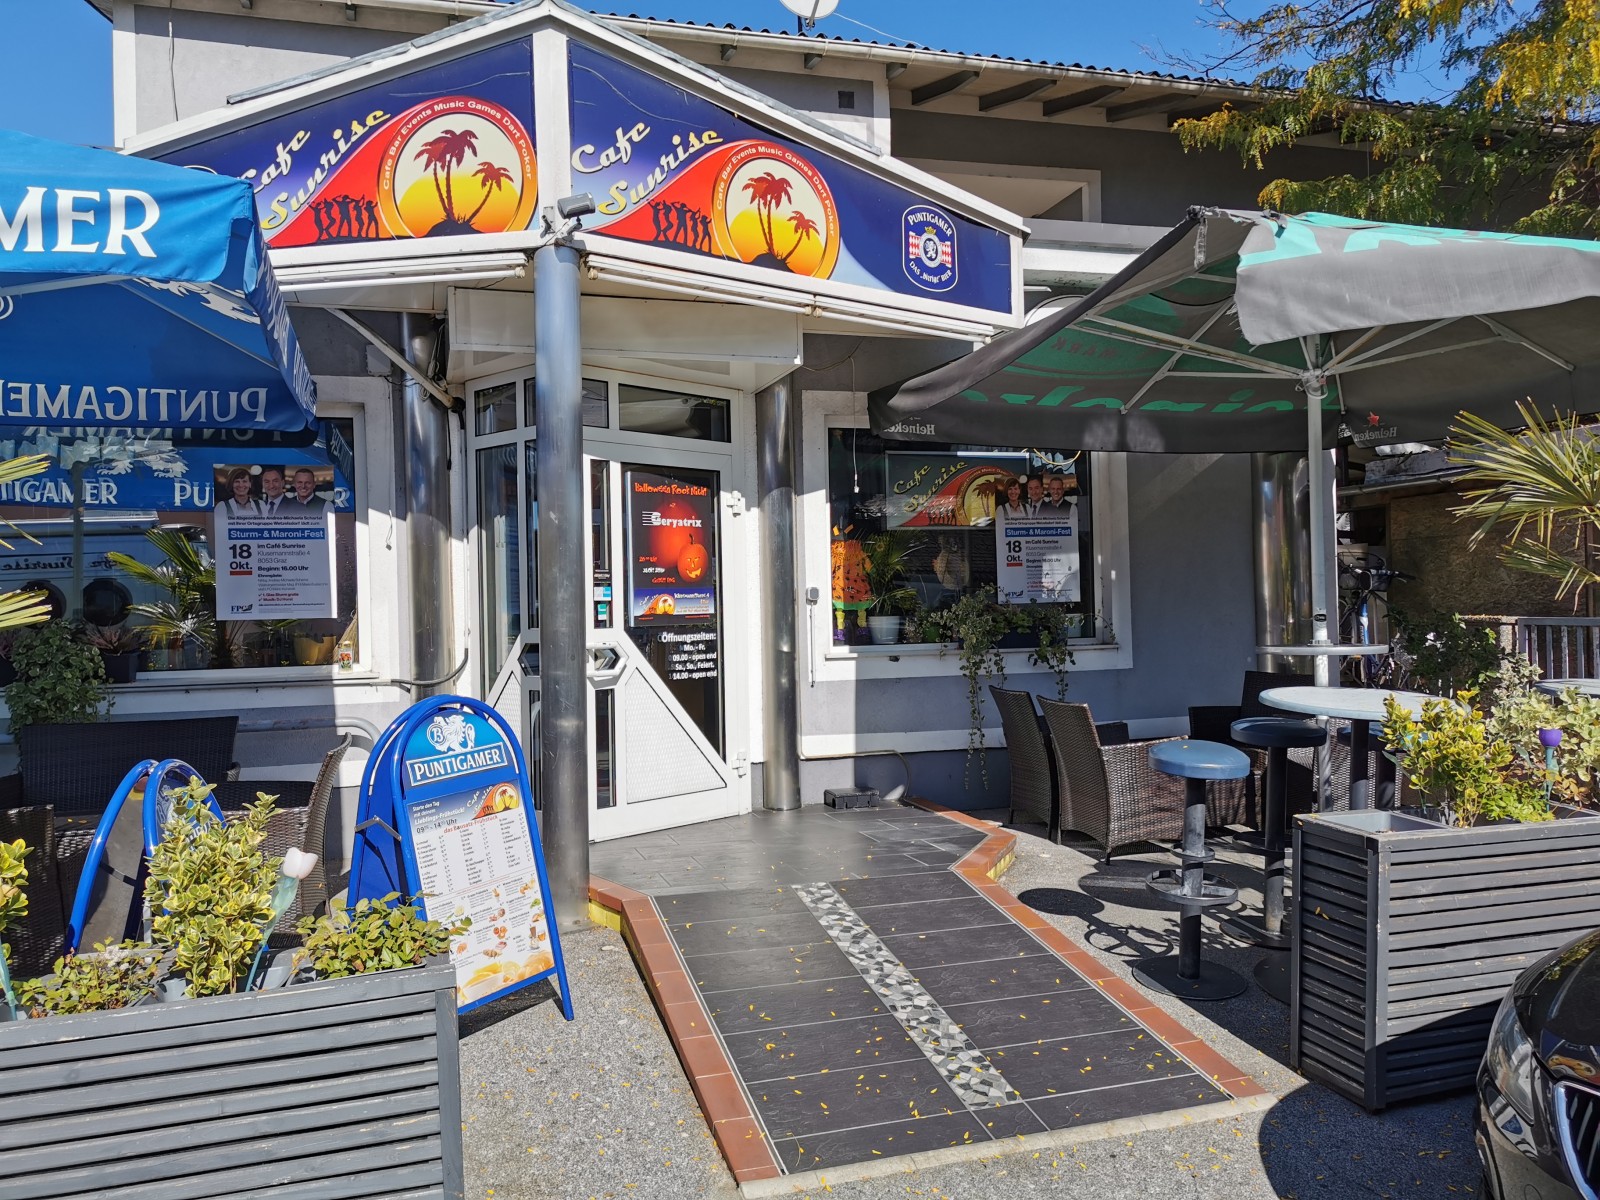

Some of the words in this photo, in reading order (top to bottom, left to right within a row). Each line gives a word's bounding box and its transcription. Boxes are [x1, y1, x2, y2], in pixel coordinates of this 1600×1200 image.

[383, 159, 392, 190] Cafe
[390, 136, 402, 156] Bar
[401, 108, 432, 134] Events
[433, 100, 465, 112] Music
[467, 102, 502, 120] Games
[502, 117, 520, 138] Dart
[518, 139, 532, 181] Poker
[571, 122, 650, 174] Cafe
[260, 110, 391, 229] Sunrise
[597, 130, 724, 215] Sunrise
[717, 182, 725, 210] Cafe
[722, 162, 732, 180] Bar
[731, 148, 756, 164] Events
[758, 146, 782, 156] Music
[784, 152, 813, 176] Games
[813, 176, 827, 198] Dart
[825, 200, 834, 237] Poker
[907, 212, 952, 237] PUNTIGAMER
[909, 261, 921, 275] DAS
[893, 464, 931, 494] Cafe
[904, 461, 968, 512] Sunrise
[229, 544, 252, 559] 18
[1006, 540, 1022, 553] 18
[230, 561, 253, 570] Okt.
[662, 631, 716, 642] Öffnungszeiten:
[673, 654, 688, 662] 09.00
[675, 663, 685, 671] Sa.,
[686, 662, 697, 670] So.,
[673, 672, 689, 680] 14.00
[431, 728, 444, 742] B
[413, 749, 501, 781] PUNTIGAMER
[412, 804, 425, 812] Starte
[415, 807, 465, 825] Lieblings-Frühstück!
[443, 826, 453, 834] das
